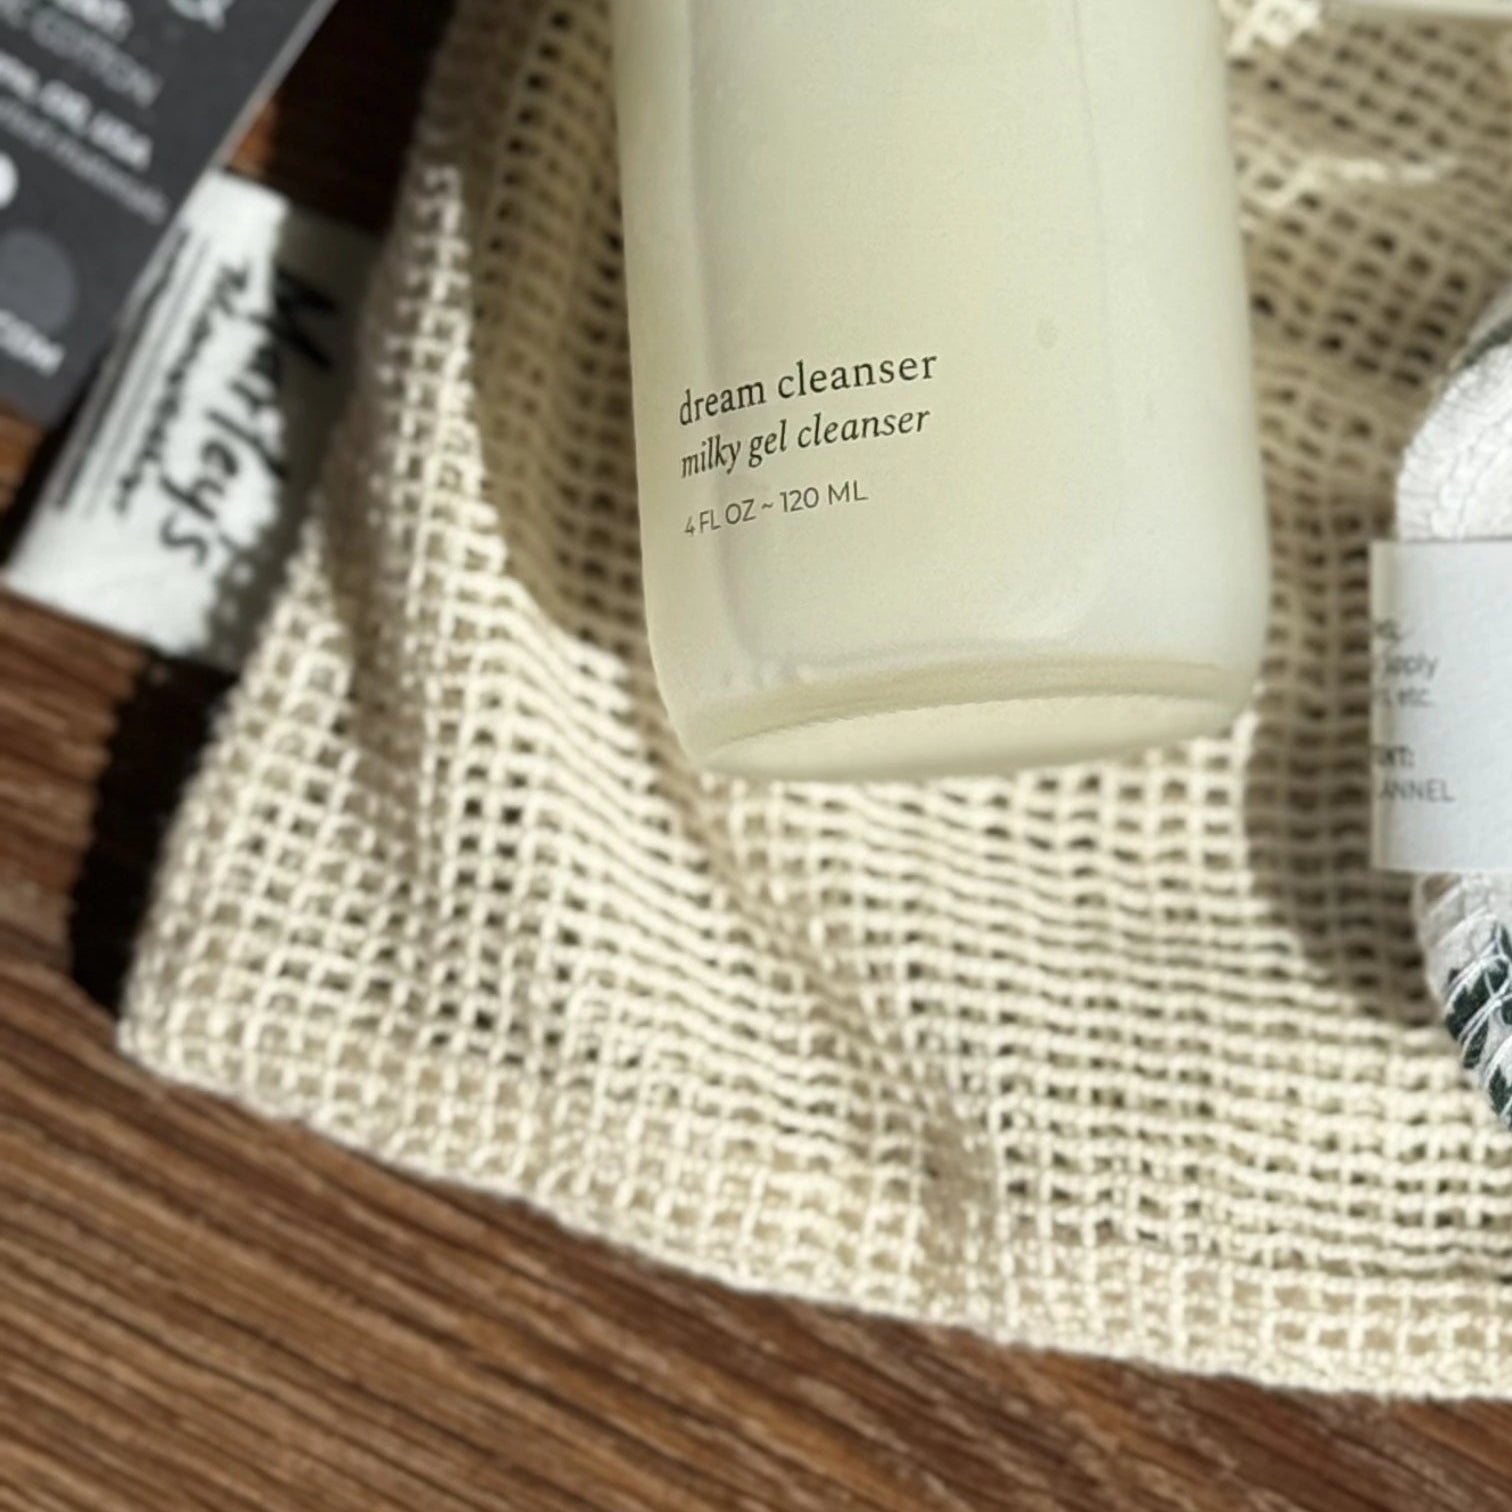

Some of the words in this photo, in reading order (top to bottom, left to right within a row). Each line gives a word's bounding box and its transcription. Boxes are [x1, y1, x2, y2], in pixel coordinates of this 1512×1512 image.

[679, 380, 766, 426] dream
[777, 355, 937, 399] cleanser
[681, 434, 741, 478] milky
[748, 419, 788, 468] gel
[797, 409, 930, 449] cleanser
[684, 516, 695, 537] 4
[699, 510, 720, 533] FL
[725, 499, 756, 524] OZ
[780, 487, 819, 513] 120
[828, 480, 868, 505] ML
